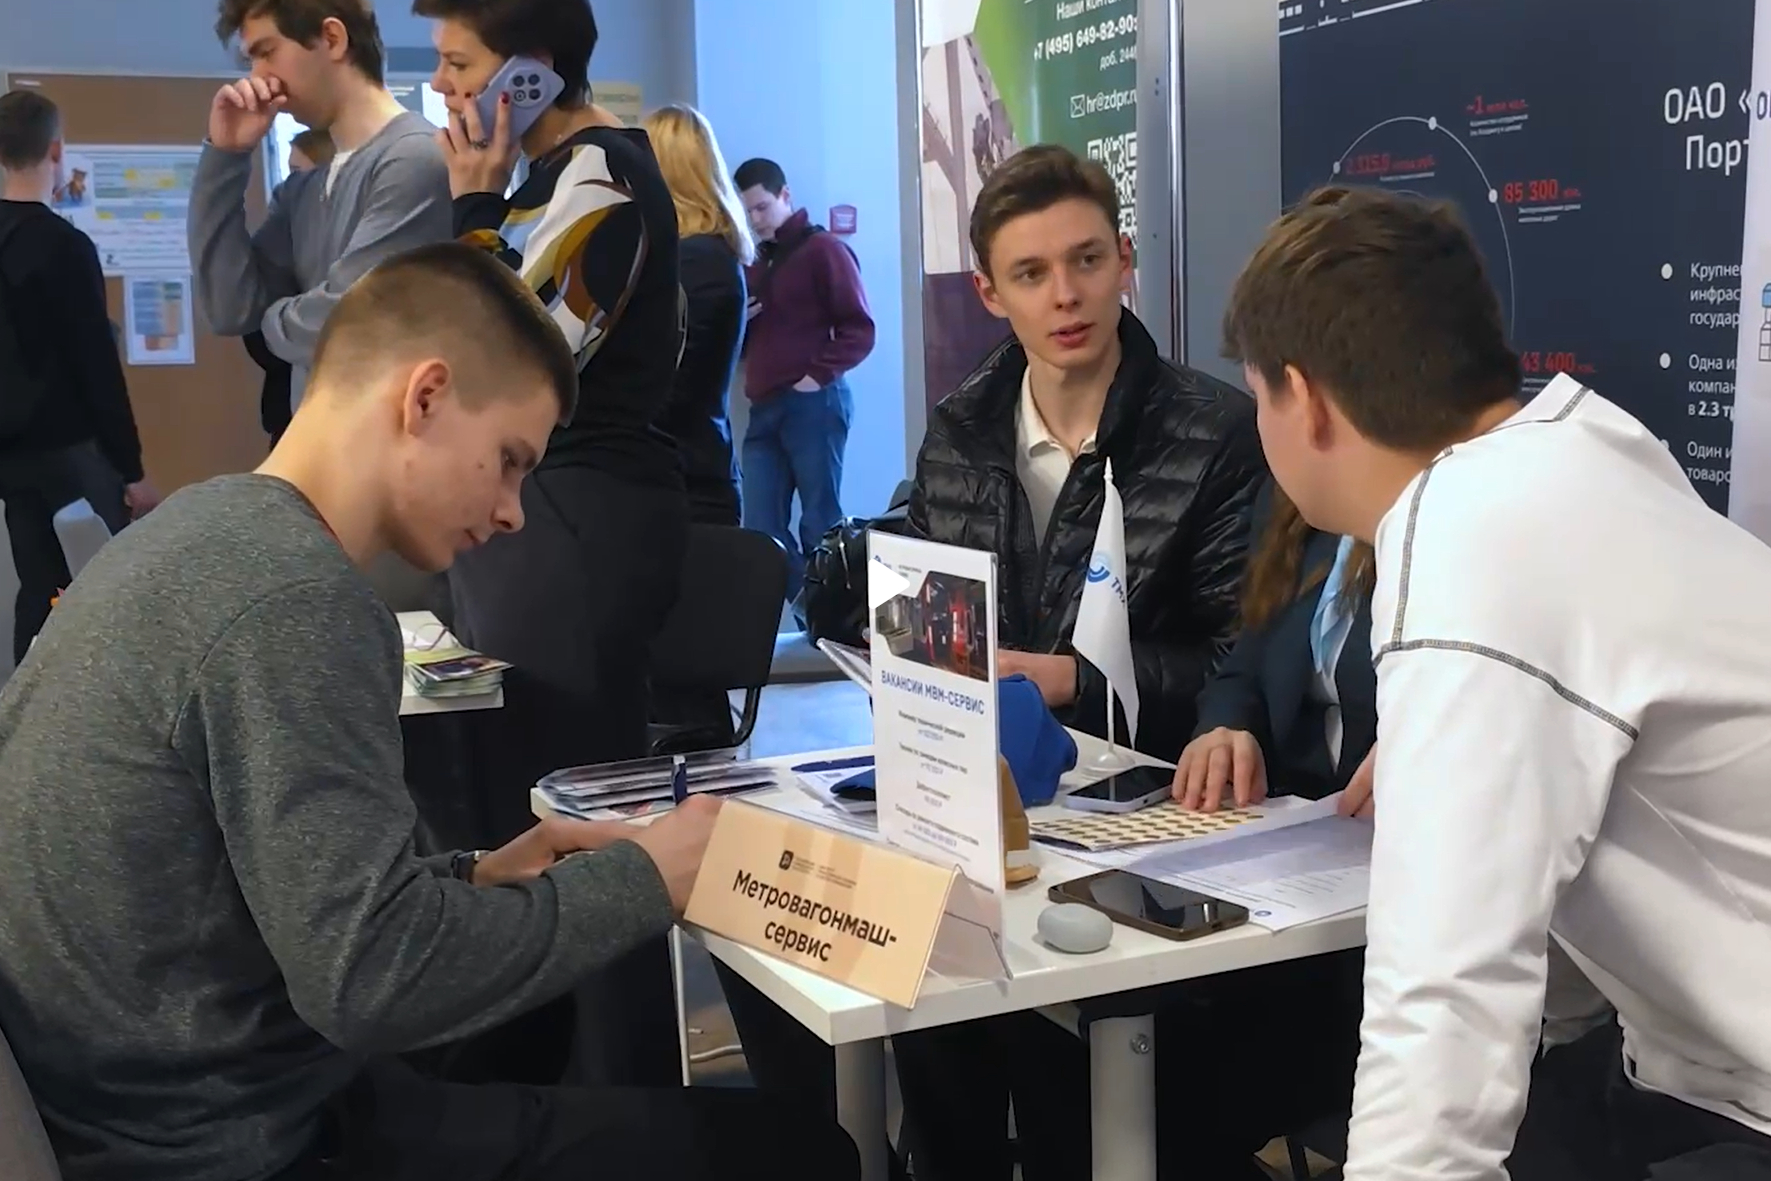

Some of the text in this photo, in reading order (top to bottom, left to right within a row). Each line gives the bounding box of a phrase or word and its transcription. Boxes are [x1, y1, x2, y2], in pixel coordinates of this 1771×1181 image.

[1045, 32, 1073, 60] (495)
[1664, 82, 1726, 124] ОАО
[1504, 182, 1523, 203] 85
[1529, 179, 1558, 201] 300
[1690, 262, 1742, 282] Крупне
[1690, 286, 1741, 305] инфрас
[1689, 312, 1740, 329] государ
[1689, 354, 1737, 372] Одна и
[1688, 404, 1696, 416] в
[1698, 400, 1720, 417] 2.3
[1687, 441, 1722, 459] Один
[882, 670, 985, 715] ВАКАНСИИ МВМ-СЕРВИС
[732, 869, 897, 947] Метровагонмаш-
[764, 921, 832, 962] сервис
